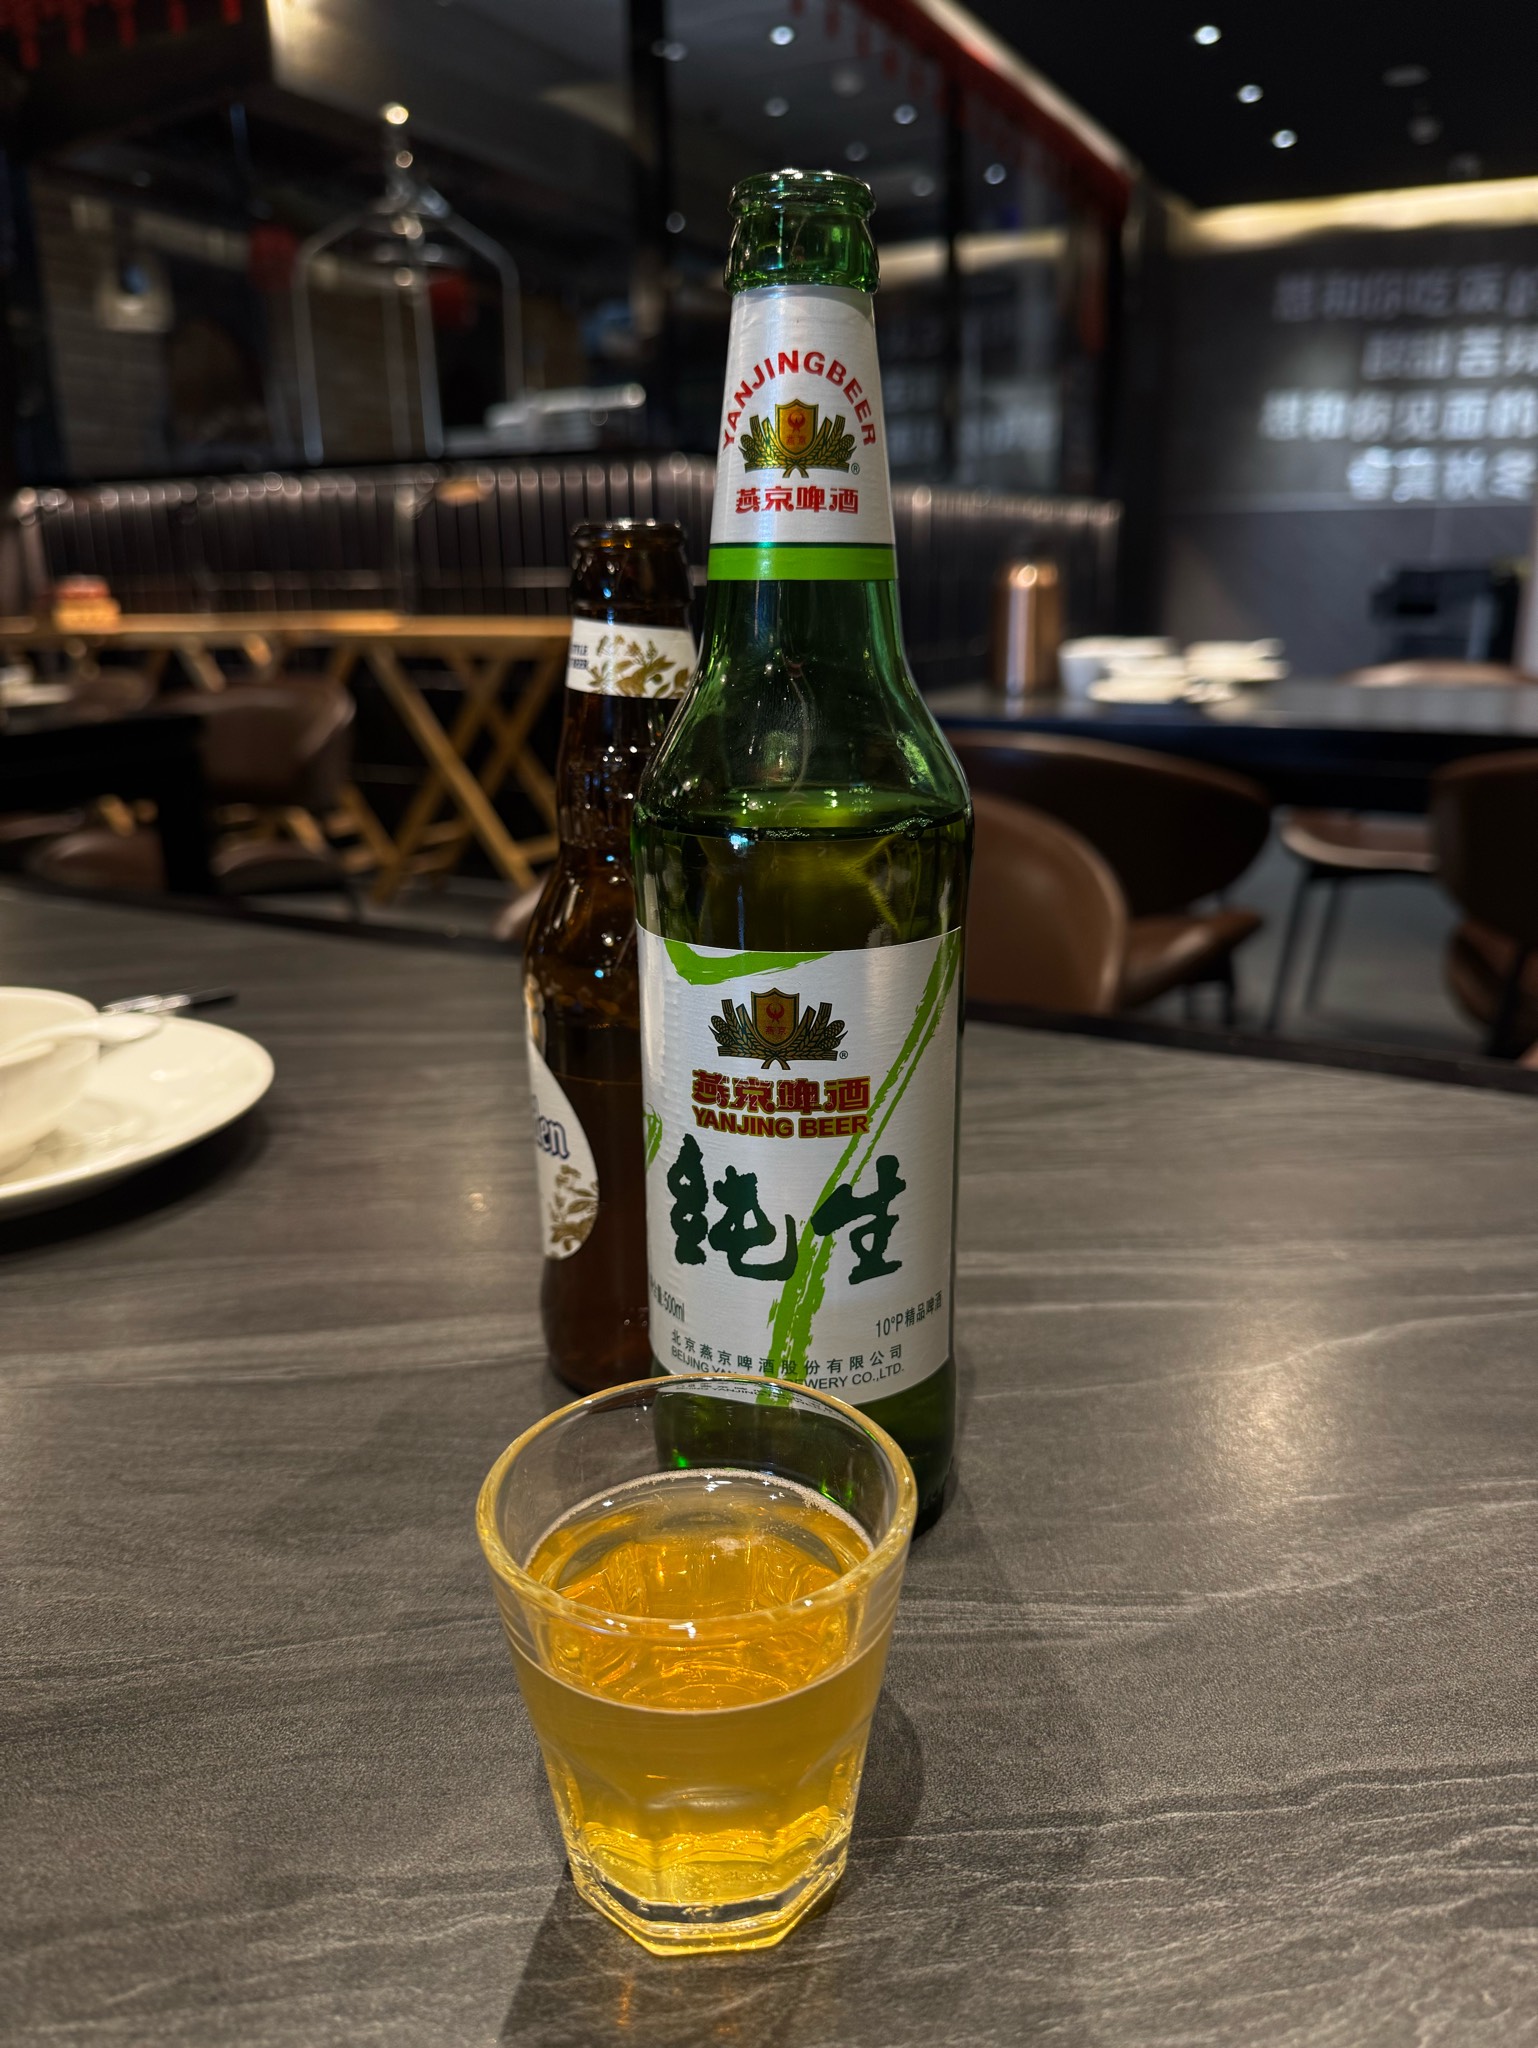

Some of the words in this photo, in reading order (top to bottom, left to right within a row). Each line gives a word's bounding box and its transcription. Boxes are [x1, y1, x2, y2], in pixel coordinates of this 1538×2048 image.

[735, 486, 859, 515] 燕京啤酒
[692, 1069, 871, 1116] 燕京啤酒
[692, 1105, 794, 1139] YANJING
[798, 1115, 870, 1139] BEER
[667, 1133, 906, 1285] 纯生
[671, 1345, 709, 1373] BEIJING
